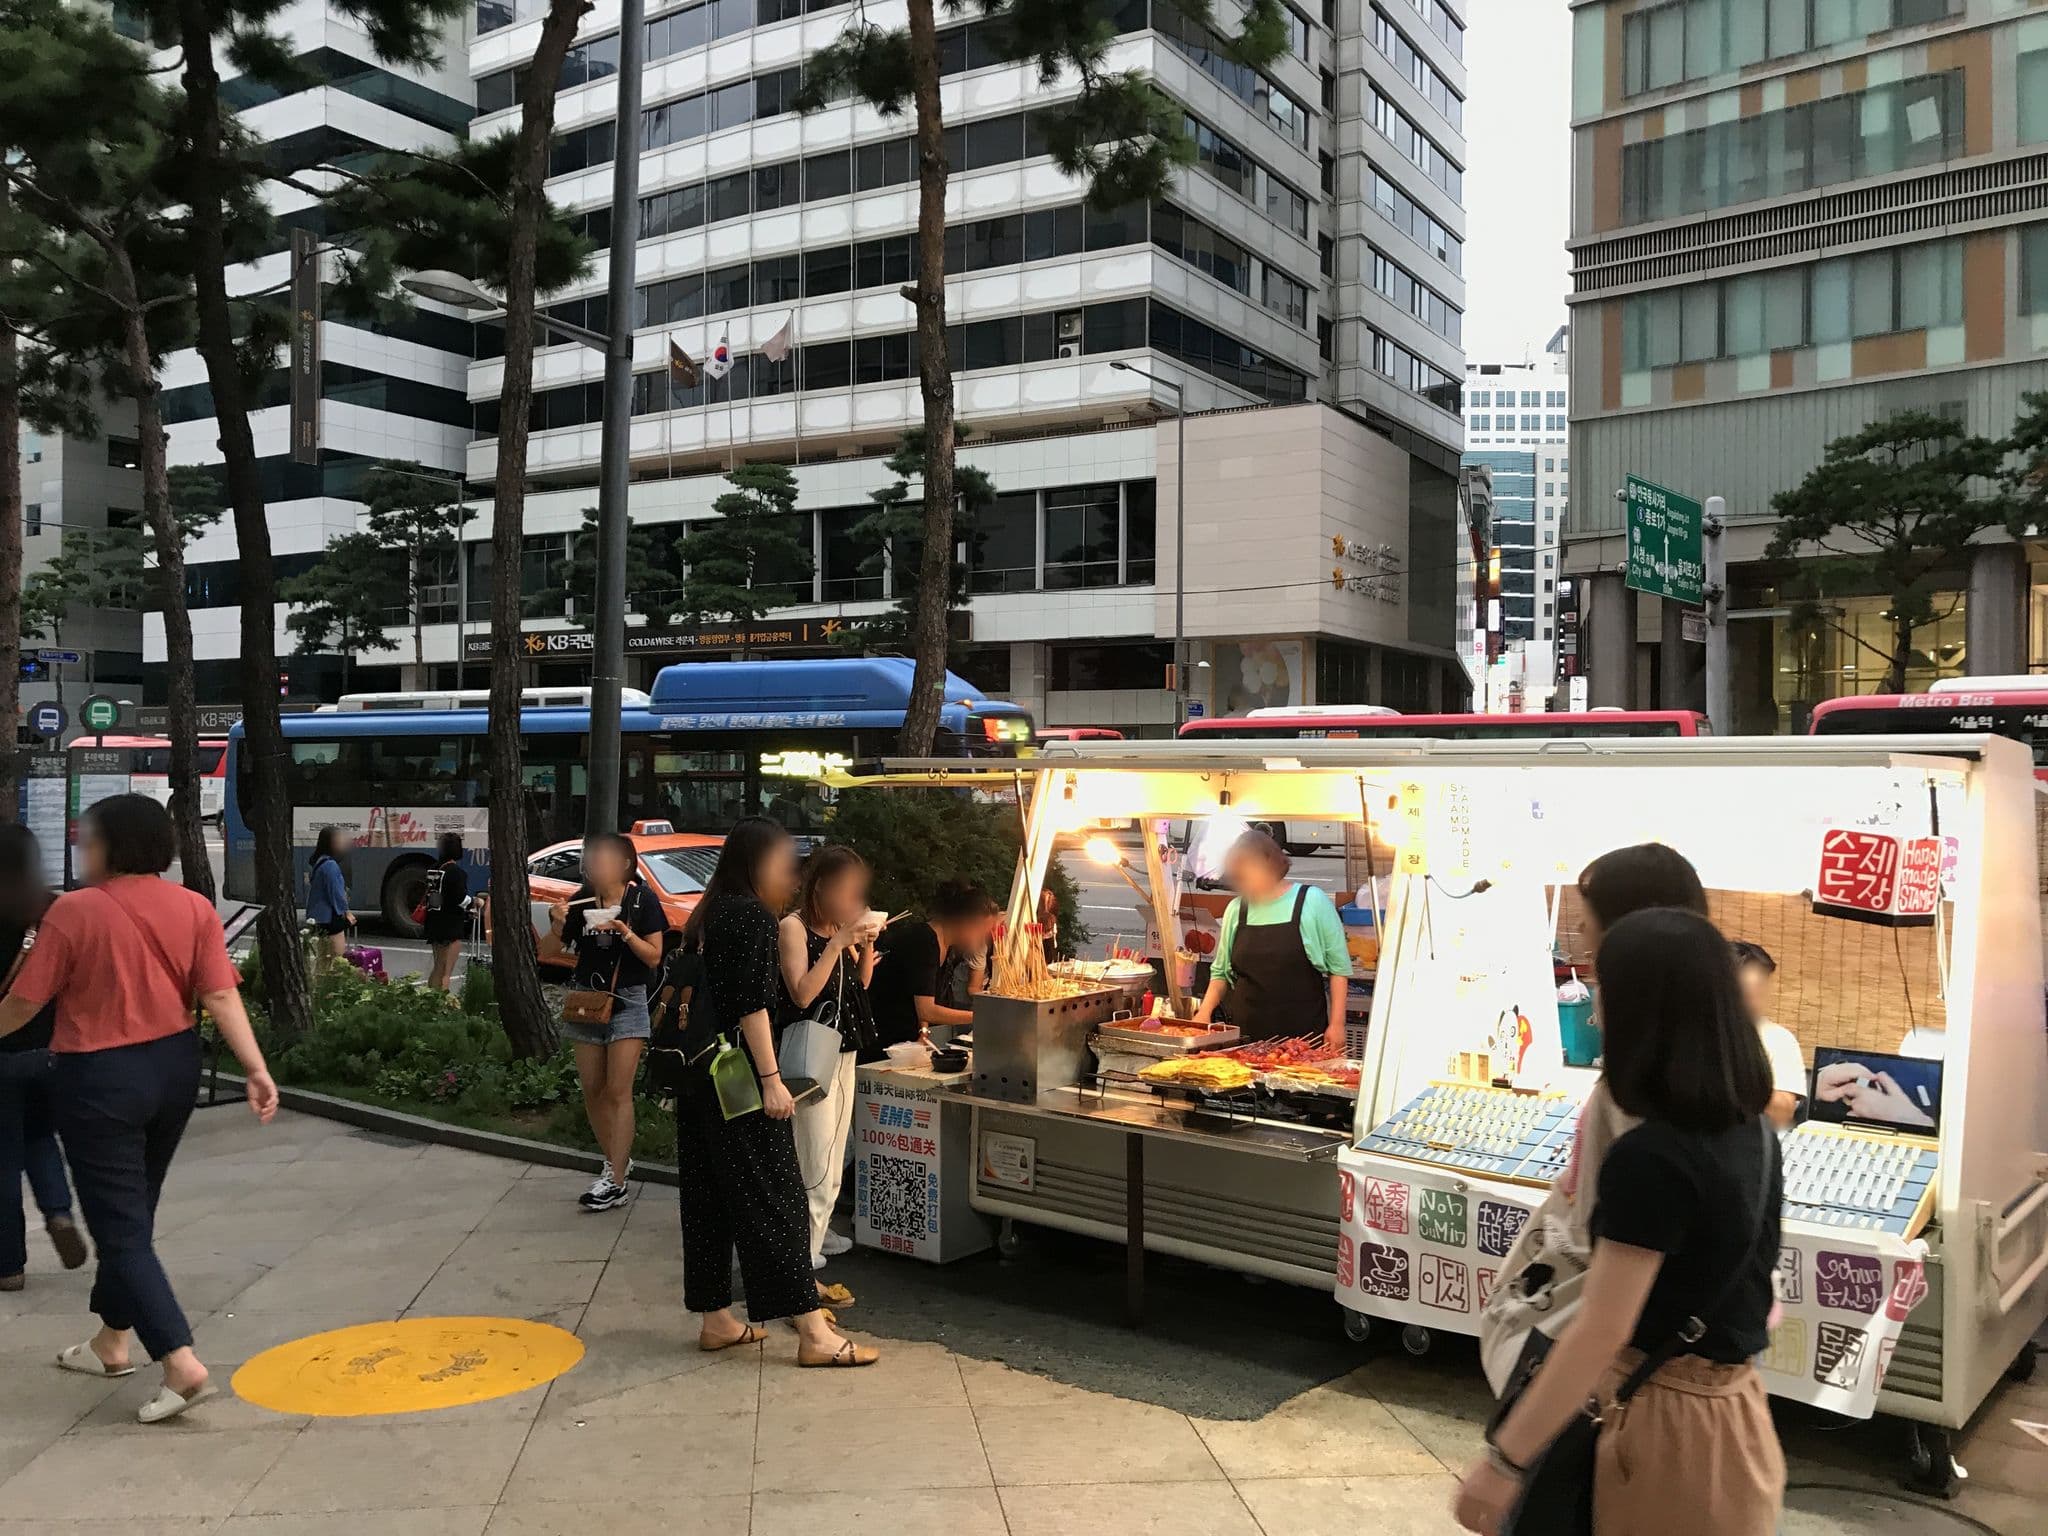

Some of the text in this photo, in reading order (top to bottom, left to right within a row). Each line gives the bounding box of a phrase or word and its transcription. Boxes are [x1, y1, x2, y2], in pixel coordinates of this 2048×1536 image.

[1645, 508, 1666, 531] 종로1가
[1632, 544, 1645, 565] 시청
[1677, 558, 1701, 580] 을지로2가
[628, 636, 675, 648] GOLD&WISE
[1898, 695, 1995, 708] Metro Bus
[1950, 715, 1993, 729] 서울역
[1406, 783, 1421, 865] 수제장
[1824, 831, 1896, 875] 수제
[1903, 844, 1939, 867] Hand
[1822, 868, 1891, 910] 도장
[1901, 866, 1937, 889] made
[1898, 885, 1935, 911] STAMP
[878, 1104, 914, 1129] EMS
[861, 1128, 937, 1157] 100%包通关
[926, 1172, 939, 1234] 免费打包
[1420, 1190, 1463, 1216] Noh
[1419, 1212, 1466, 1245] SuMin
[1360, 1275, 1409, 1299] Coffee
